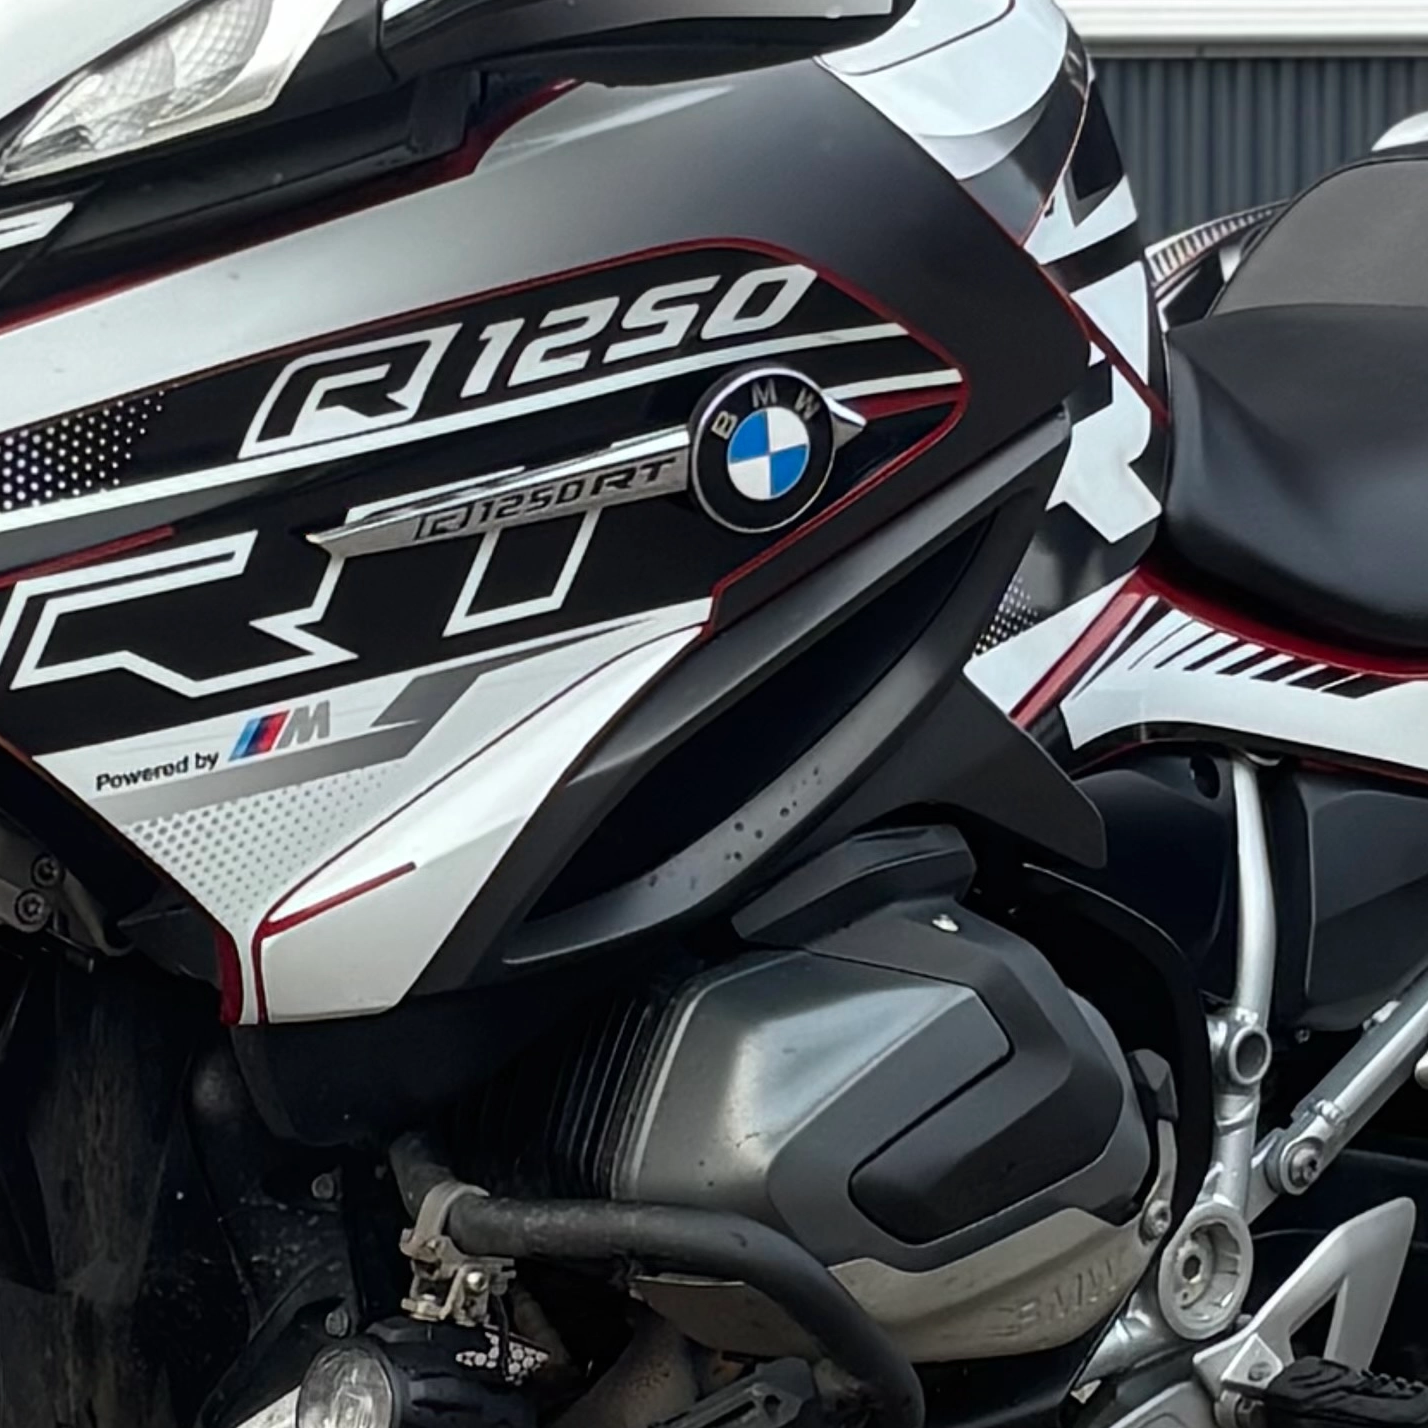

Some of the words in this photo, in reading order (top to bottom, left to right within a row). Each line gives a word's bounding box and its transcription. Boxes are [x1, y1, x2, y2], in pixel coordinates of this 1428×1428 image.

[710, 378, 822, 440] BMW
[95, 756, 189, 791] Powered
[194, 751, 220, 771] by
